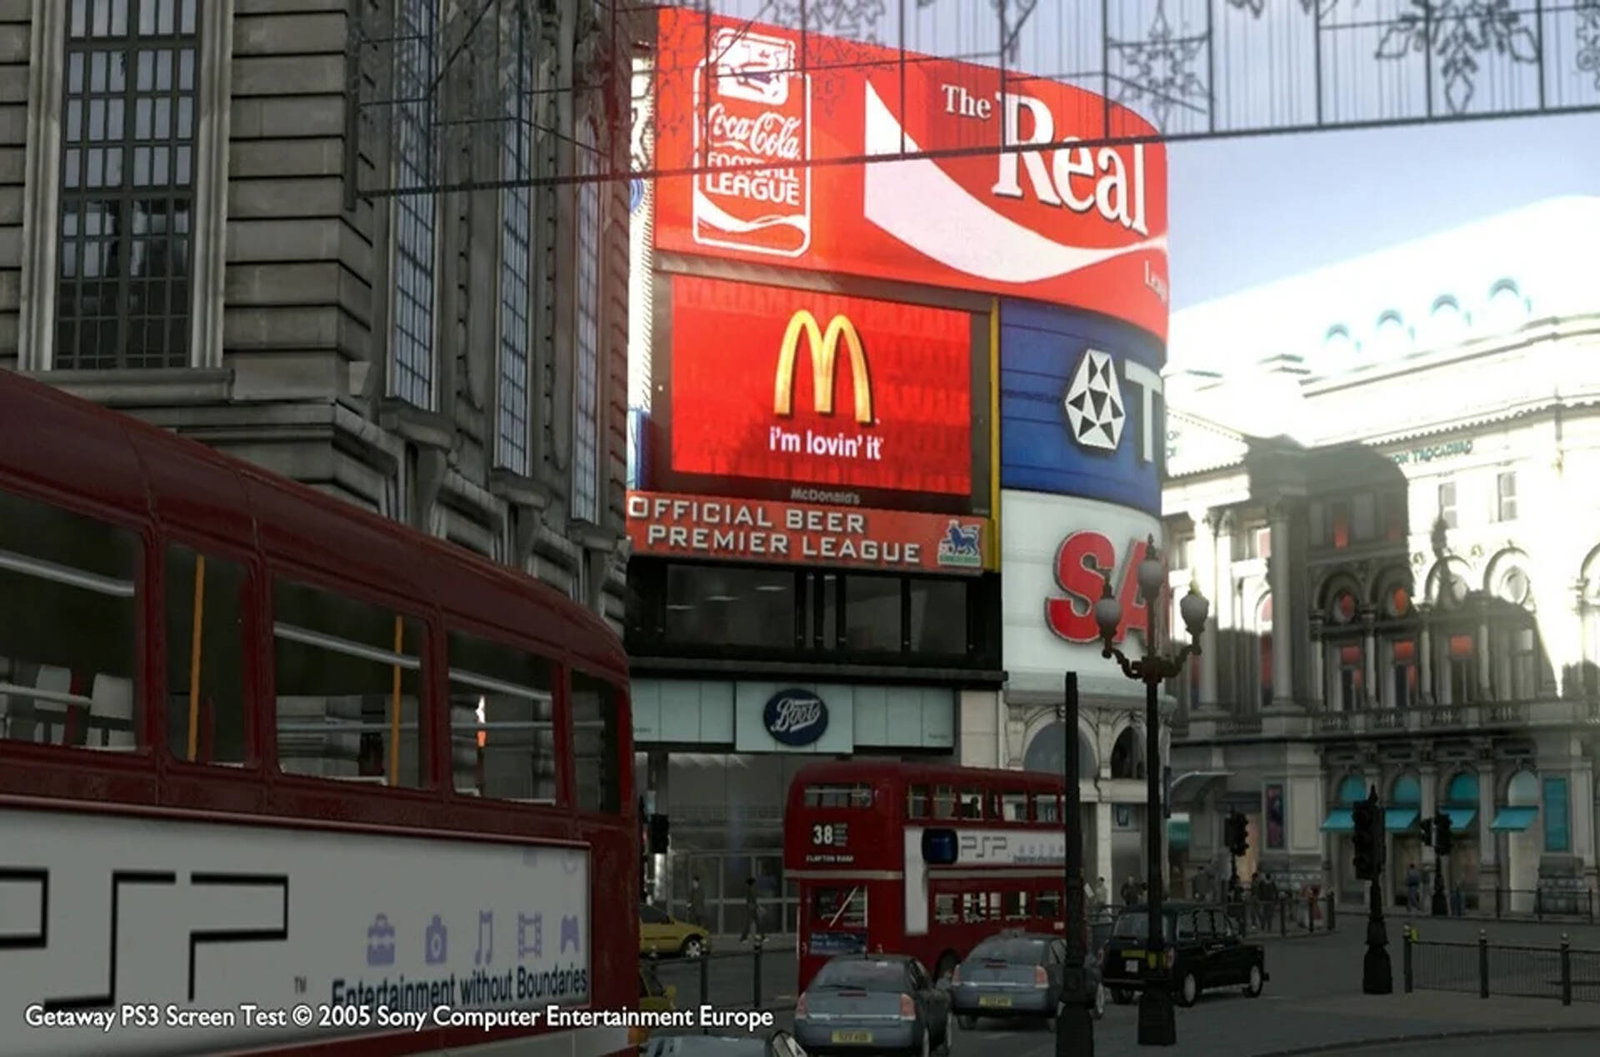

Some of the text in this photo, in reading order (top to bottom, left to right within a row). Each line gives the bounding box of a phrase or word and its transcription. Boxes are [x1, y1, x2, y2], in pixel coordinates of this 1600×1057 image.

[941, 84, 1149, 235] The Real
[706, 171, 800, 206] LEAGUE
[769, 427, 882, 460] i'm lovin' it
[790, 485, 861, 505] McDonald's
[628, 496, 865, 533] OFFICIAL BEER
[648, 525, 921, 564] PREMIER LEAGUE
[813, 824, 834, 845] 38
[961, 835, 1007, 858] PSP
[331, 961, 588, 1012] Entertainment without Boundaries
